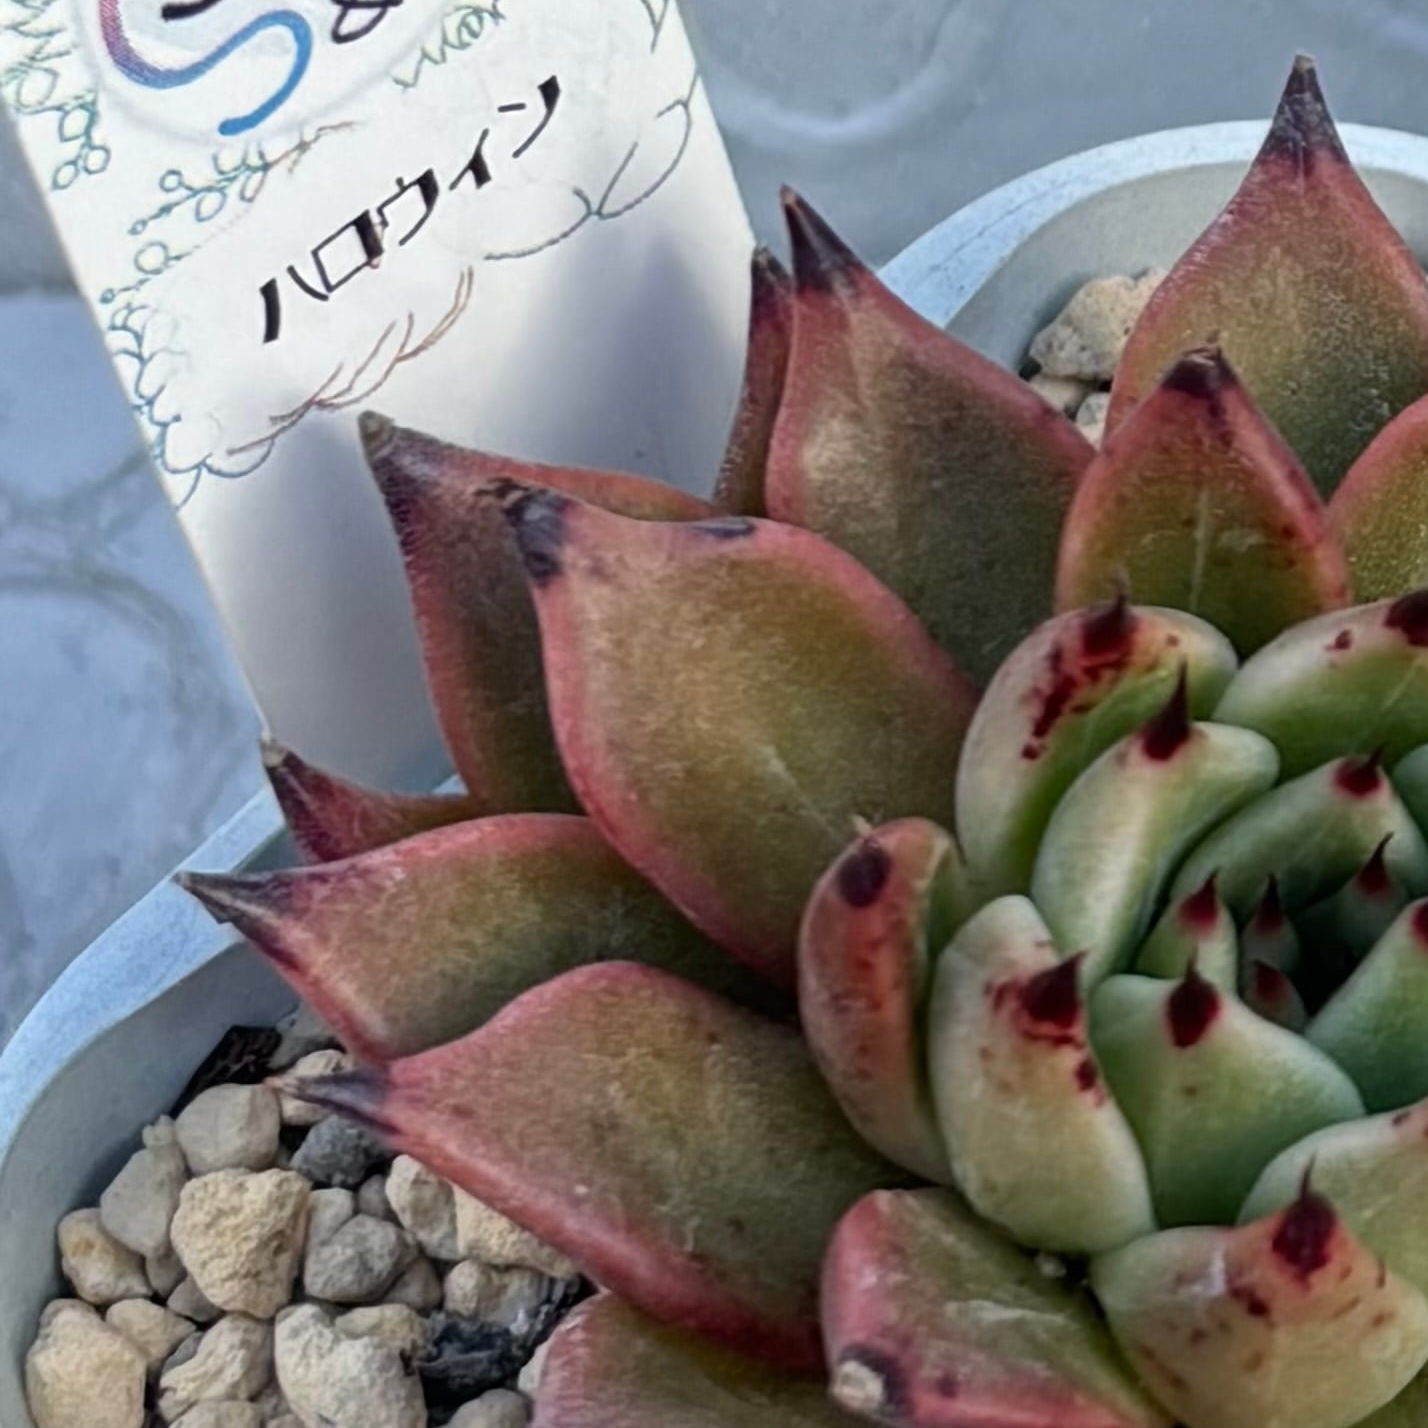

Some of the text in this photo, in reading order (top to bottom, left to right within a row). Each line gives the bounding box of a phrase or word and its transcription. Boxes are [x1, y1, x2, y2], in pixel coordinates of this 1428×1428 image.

[259, 75, 559, 343] ハロウィン
